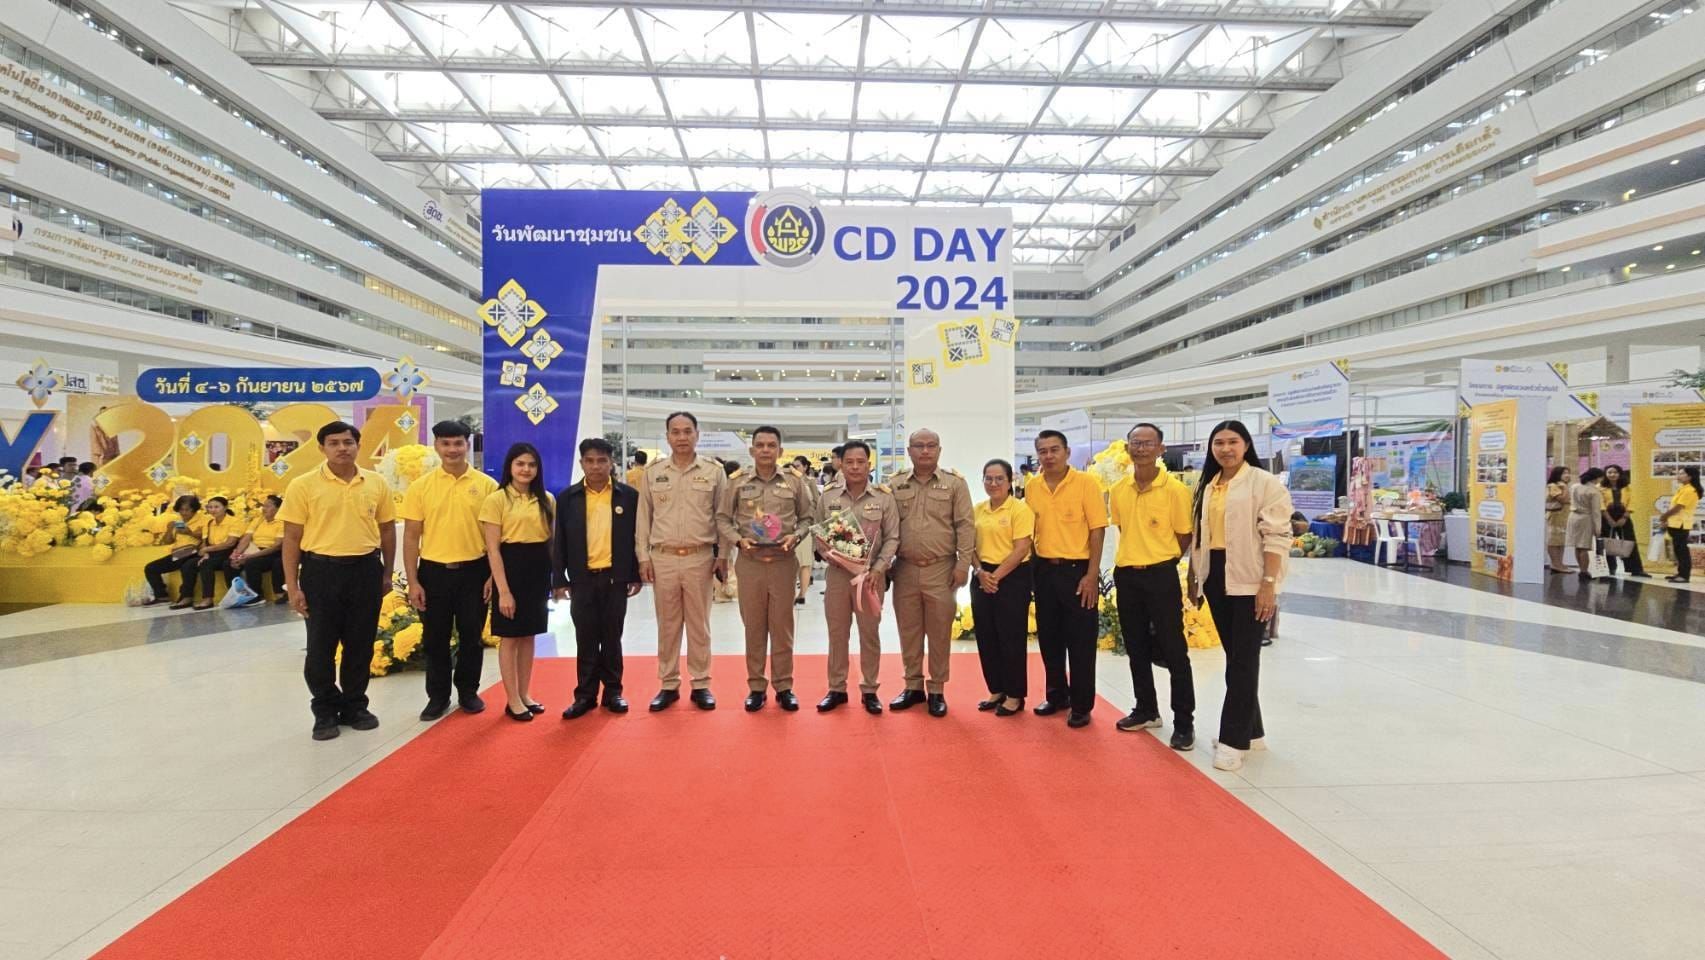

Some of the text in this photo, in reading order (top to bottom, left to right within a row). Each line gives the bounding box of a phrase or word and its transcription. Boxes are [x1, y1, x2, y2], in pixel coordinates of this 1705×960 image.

[12, 89, 60, 120] Technology
[60, 114, 110, 142] Development
[110, 139, 137, 157] Agency
[491, 223, 633, 246] วันพัฒนาชุมชน
[833, 225, 1007, 262] CD DAY
[896, 275, 1008, 310] 2024
[155, 371, 191, 394] วันที่
[236, 376, 306, 394] กันยายน
[311, 379, 364, 393] ๒๕๖๗
